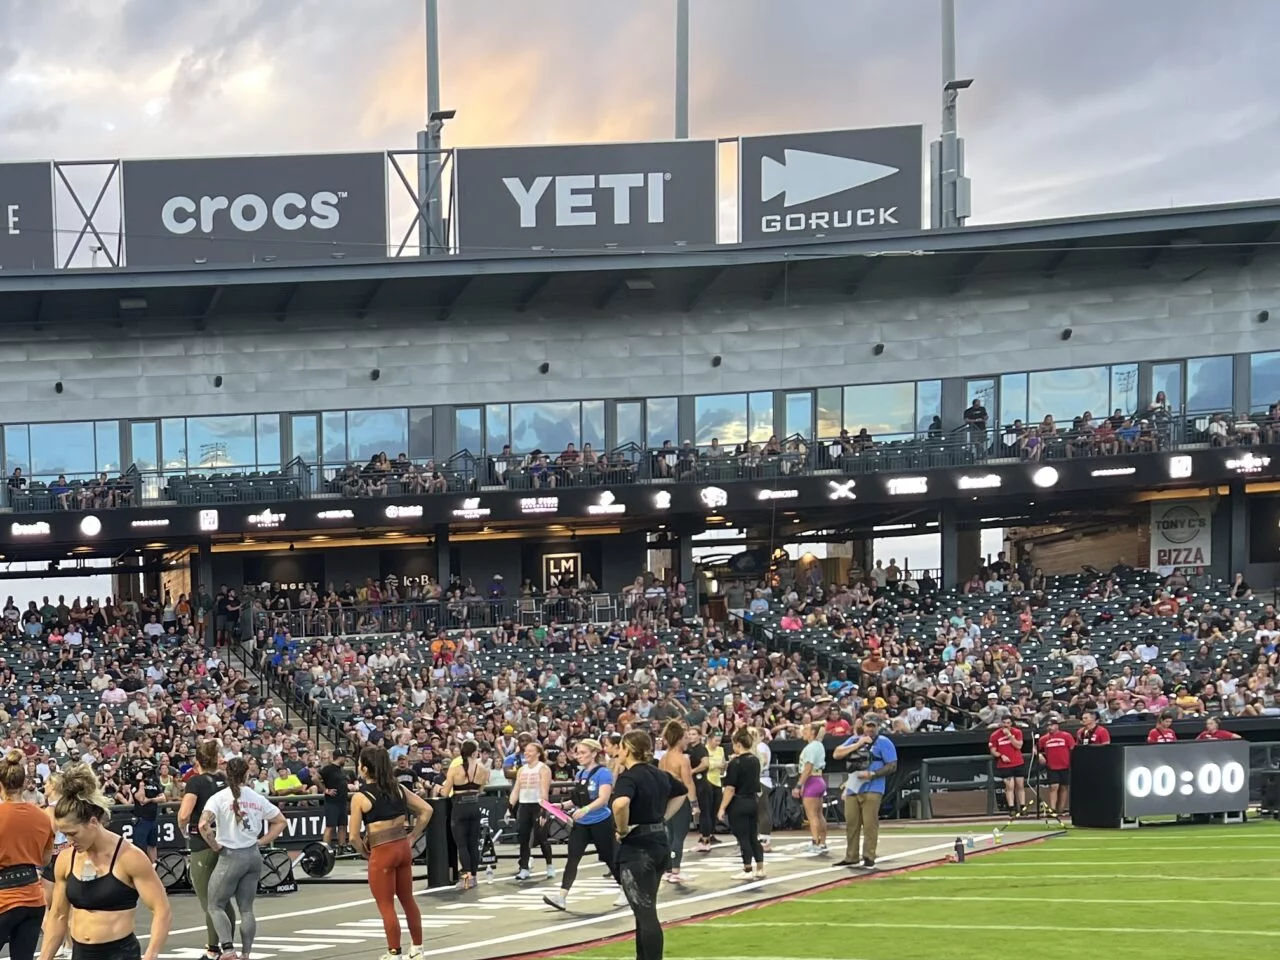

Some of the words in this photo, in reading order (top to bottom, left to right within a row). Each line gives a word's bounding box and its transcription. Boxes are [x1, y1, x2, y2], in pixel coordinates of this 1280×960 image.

[761, 207, 900, 233] GORUCK
[1157, 547, 1205, 566] PIZZA
[1128, 761, 1246, 798] 00:00
